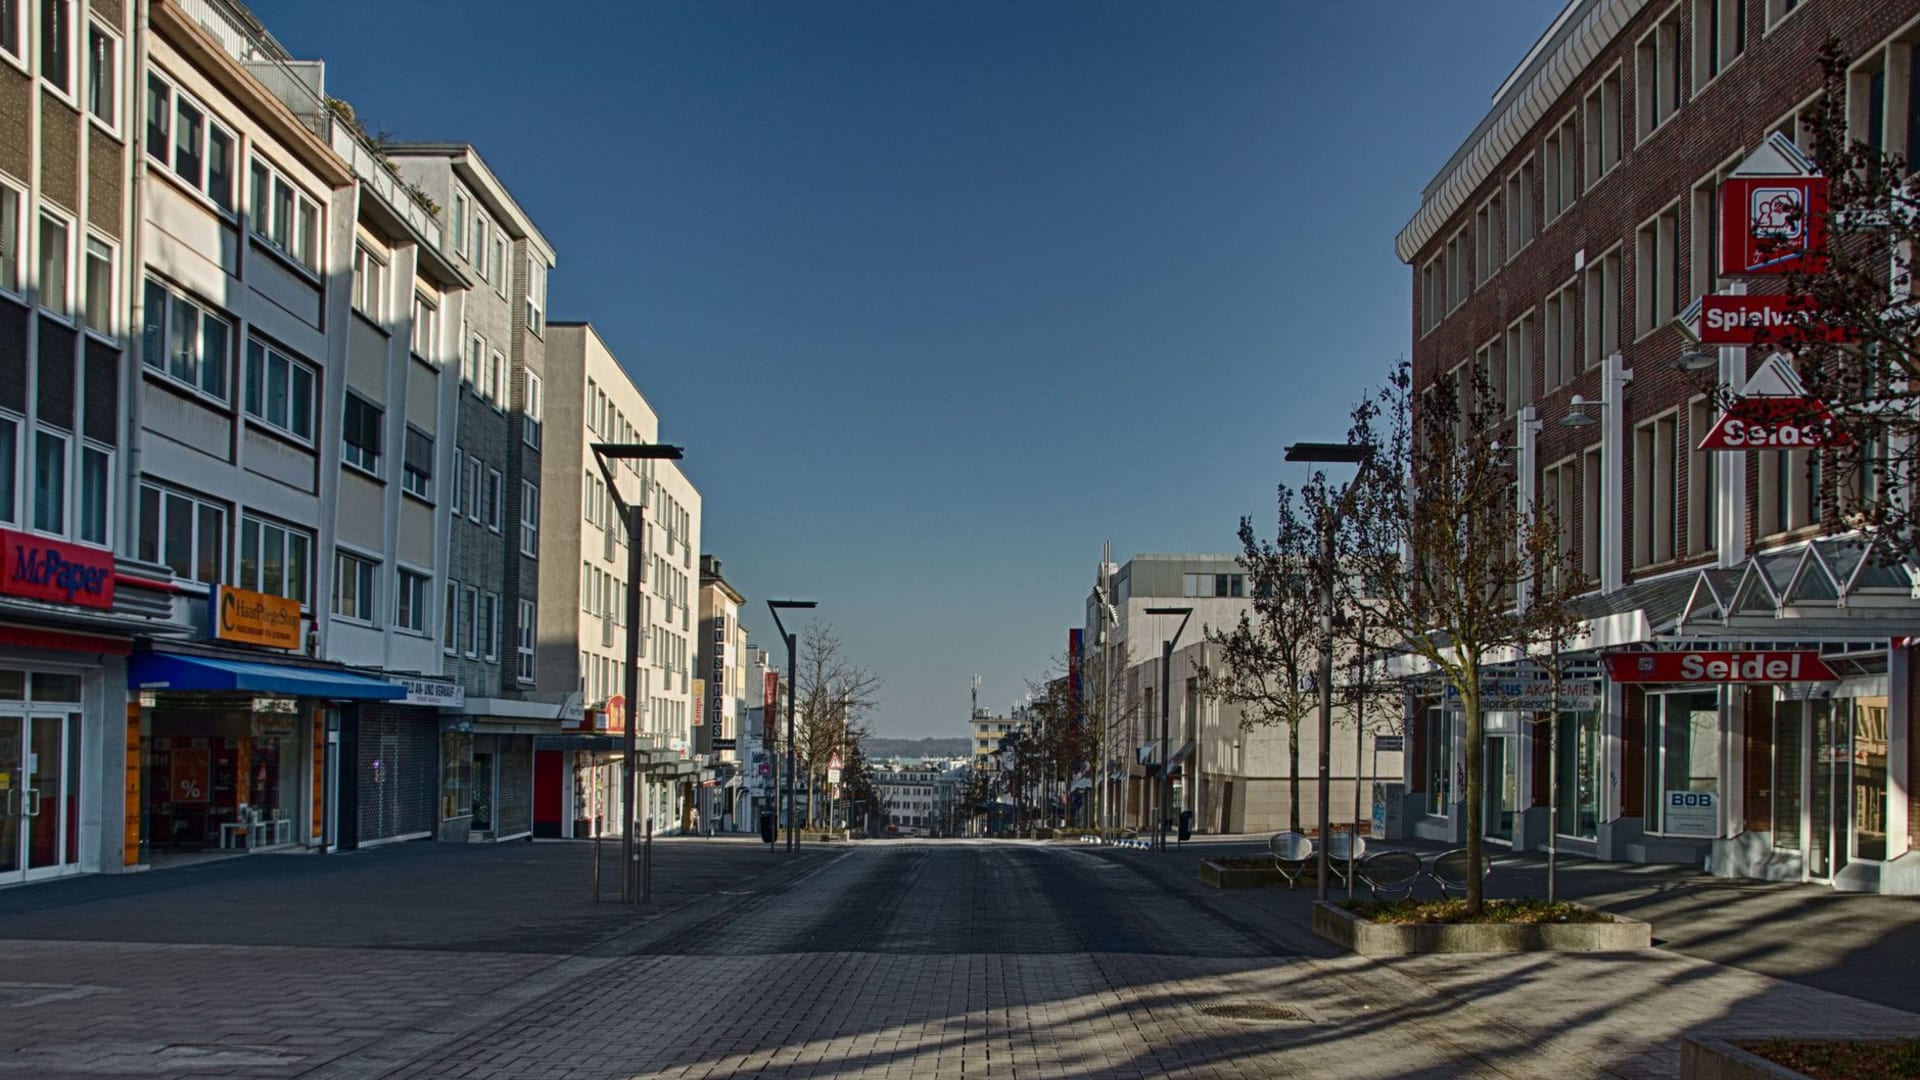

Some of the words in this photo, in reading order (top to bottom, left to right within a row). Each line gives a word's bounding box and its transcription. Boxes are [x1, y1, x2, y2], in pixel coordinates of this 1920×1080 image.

[12, 544, 108, 599] McPaper
[713, 616, 725, 738] KUNSTHAUS
[1680, 653, 1800, 679] Seidel
[1671, 793, 1711, 806] BOB
